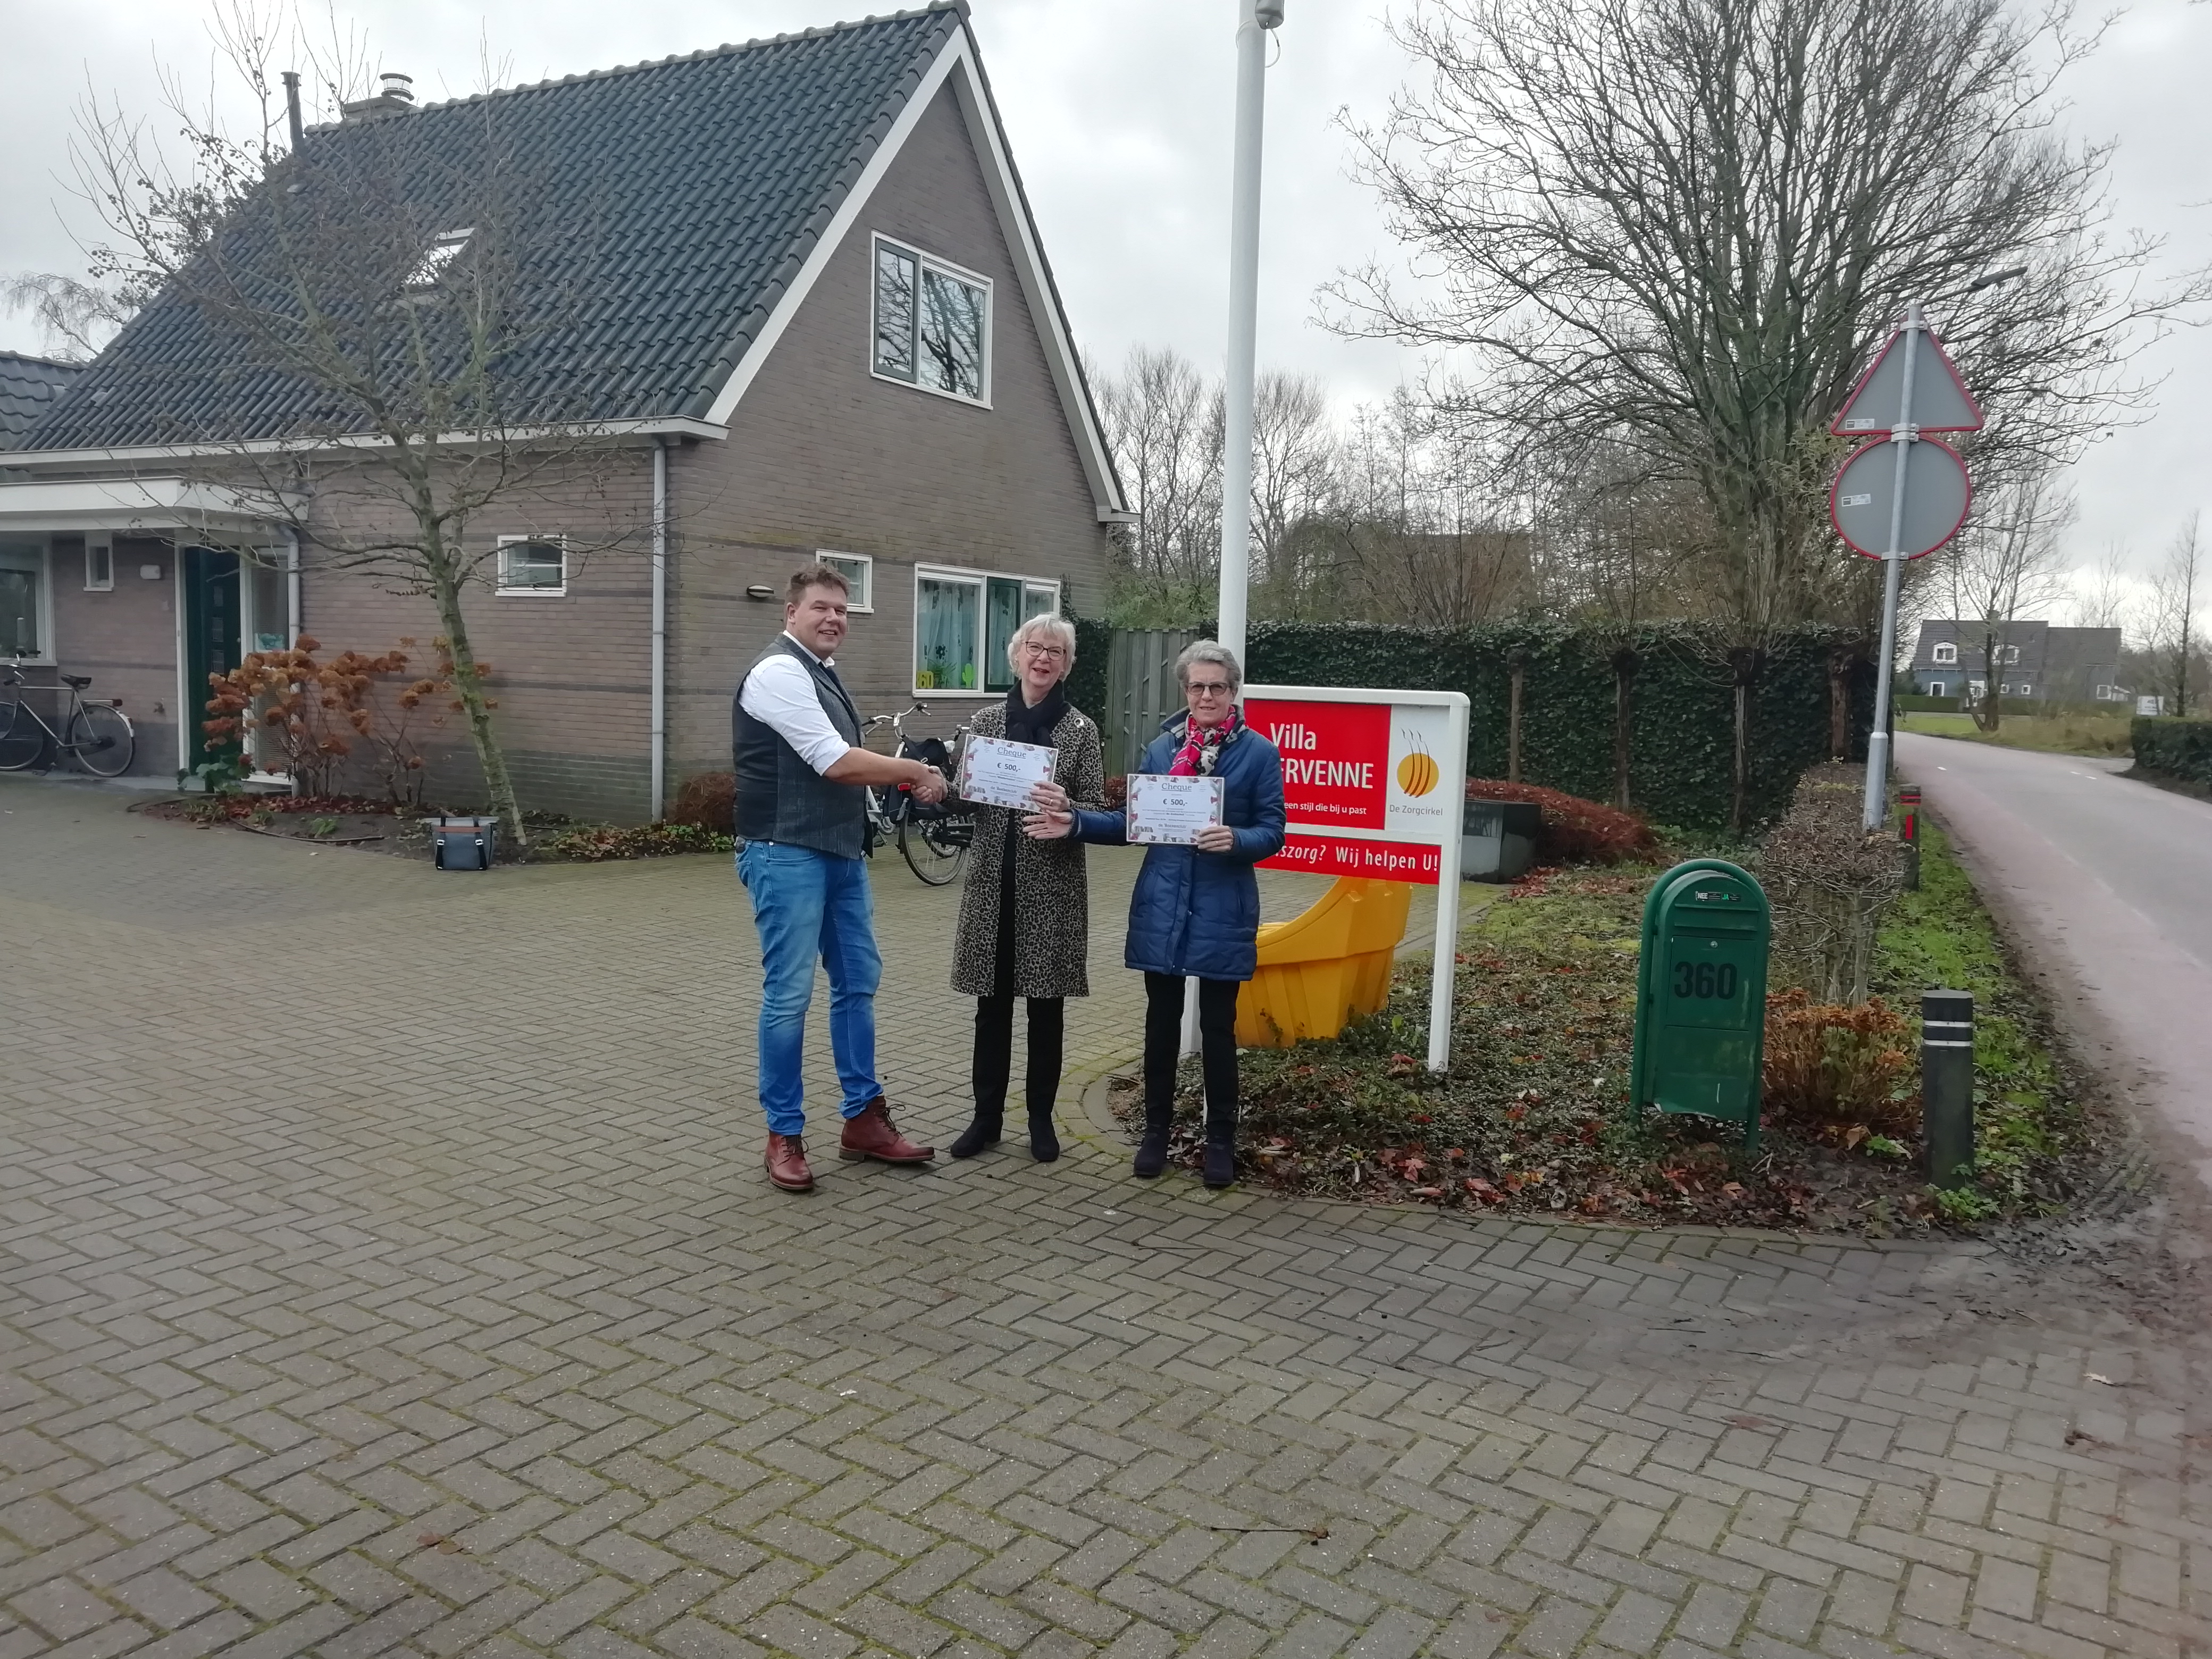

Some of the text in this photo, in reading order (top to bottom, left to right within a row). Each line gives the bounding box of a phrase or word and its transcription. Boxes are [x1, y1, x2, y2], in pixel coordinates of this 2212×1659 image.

[1270, 723, 1317, 750] Villa
[997, 747, 1027, 758] Cheque
[1004, 764, 1021, 773] 500,-
[1161, 783, 1192, 791] Cheque
[1300, 802, 1314, 812] stijl
[1316, 803, 1328, 812] die
[1330, 803, 1340, 815] bij
[1349, 807, 1367, 815] past
[1389, 804, 1443, 816] De Zorgcirkel
[1276, 844, 1438, 872] szorg? Wij helpen U!
[1674, 961, 1737, 1000] 360
